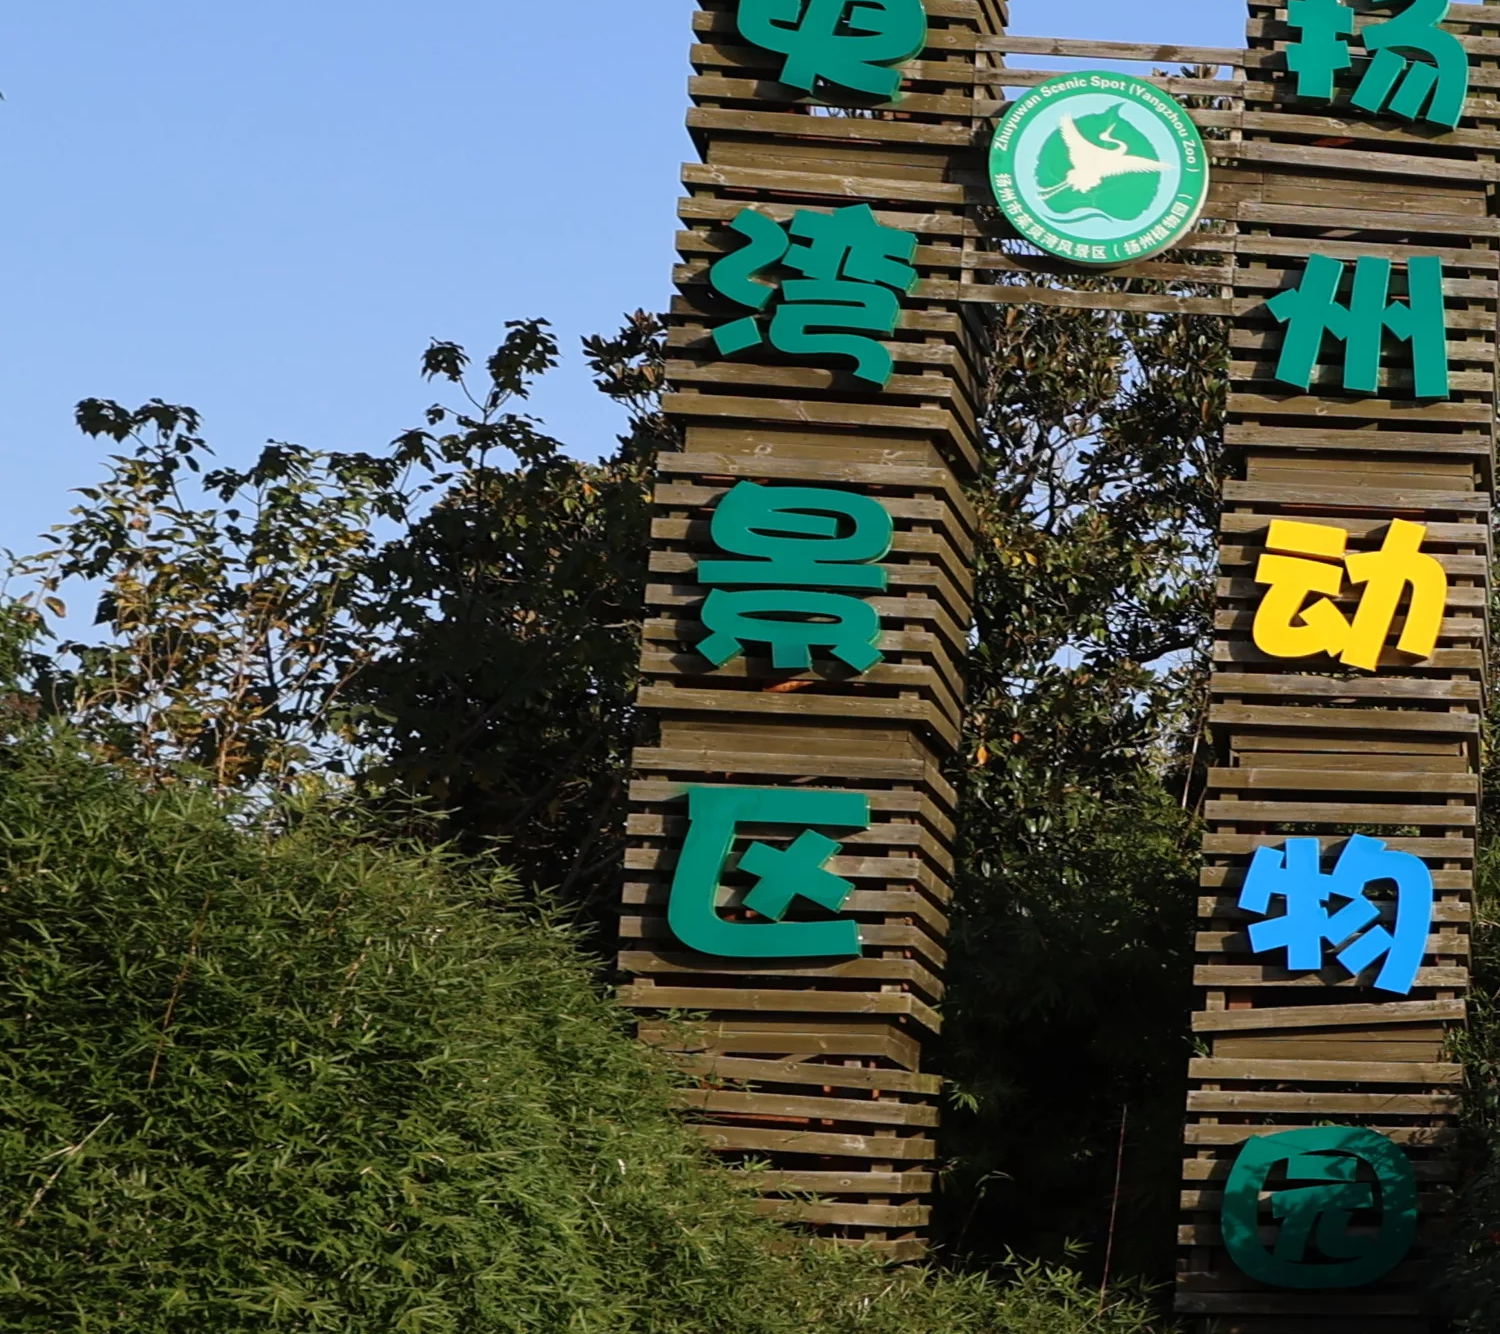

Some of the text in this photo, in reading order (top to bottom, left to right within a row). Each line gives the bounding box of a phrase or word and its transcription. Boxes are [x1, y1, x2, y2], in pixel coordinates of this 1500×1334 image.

[994, 94, 1041, 152] Zhuyuwan
[1040, 77, 1087, 97] Scenic
[1090, 75, 1126, 90] Spot
